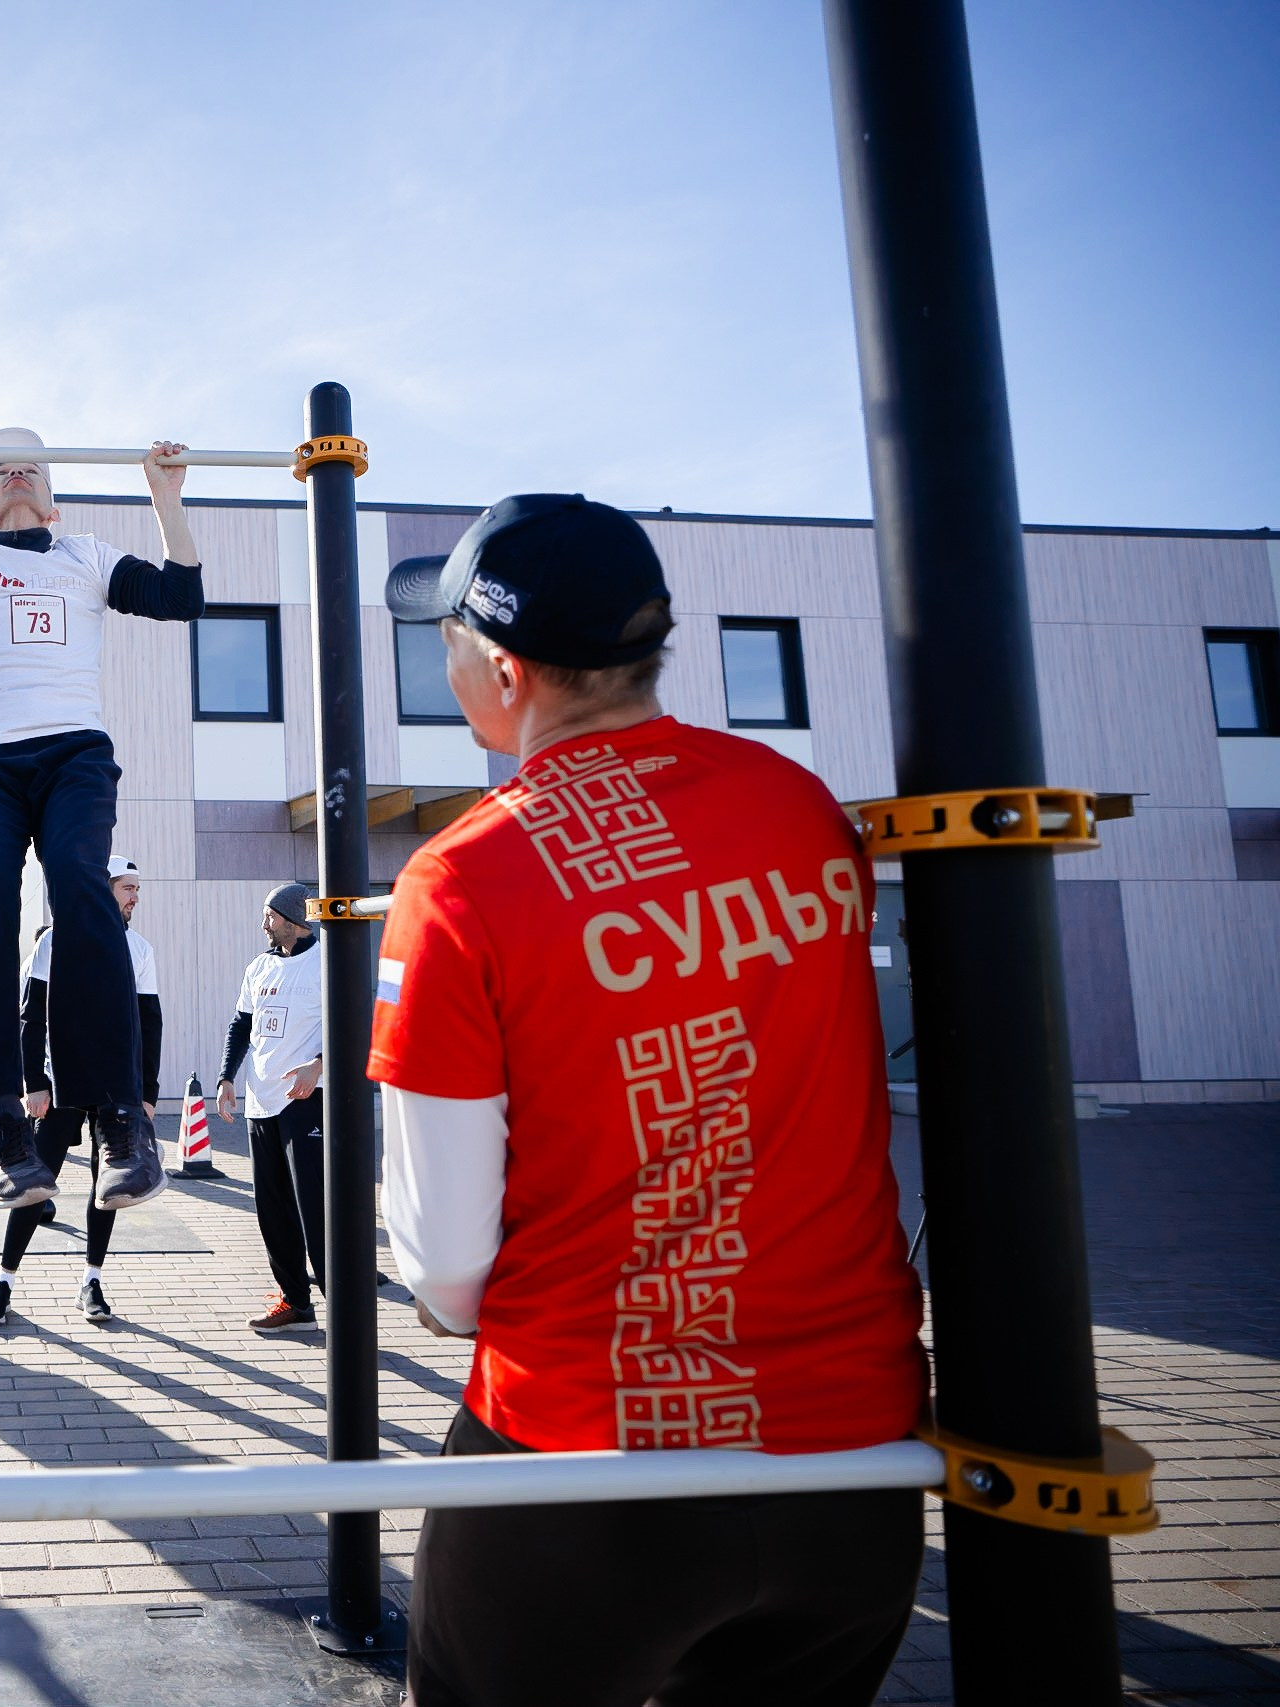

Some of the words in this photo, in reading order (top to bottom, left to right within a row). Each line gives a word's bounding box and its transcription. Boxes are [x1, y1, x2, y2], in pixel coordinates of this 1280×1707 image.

[27, 612, 51, 634] 73
[582, 857, 866, 993] СУДЬЯ
[266, 1018, 278, 1032] 49
